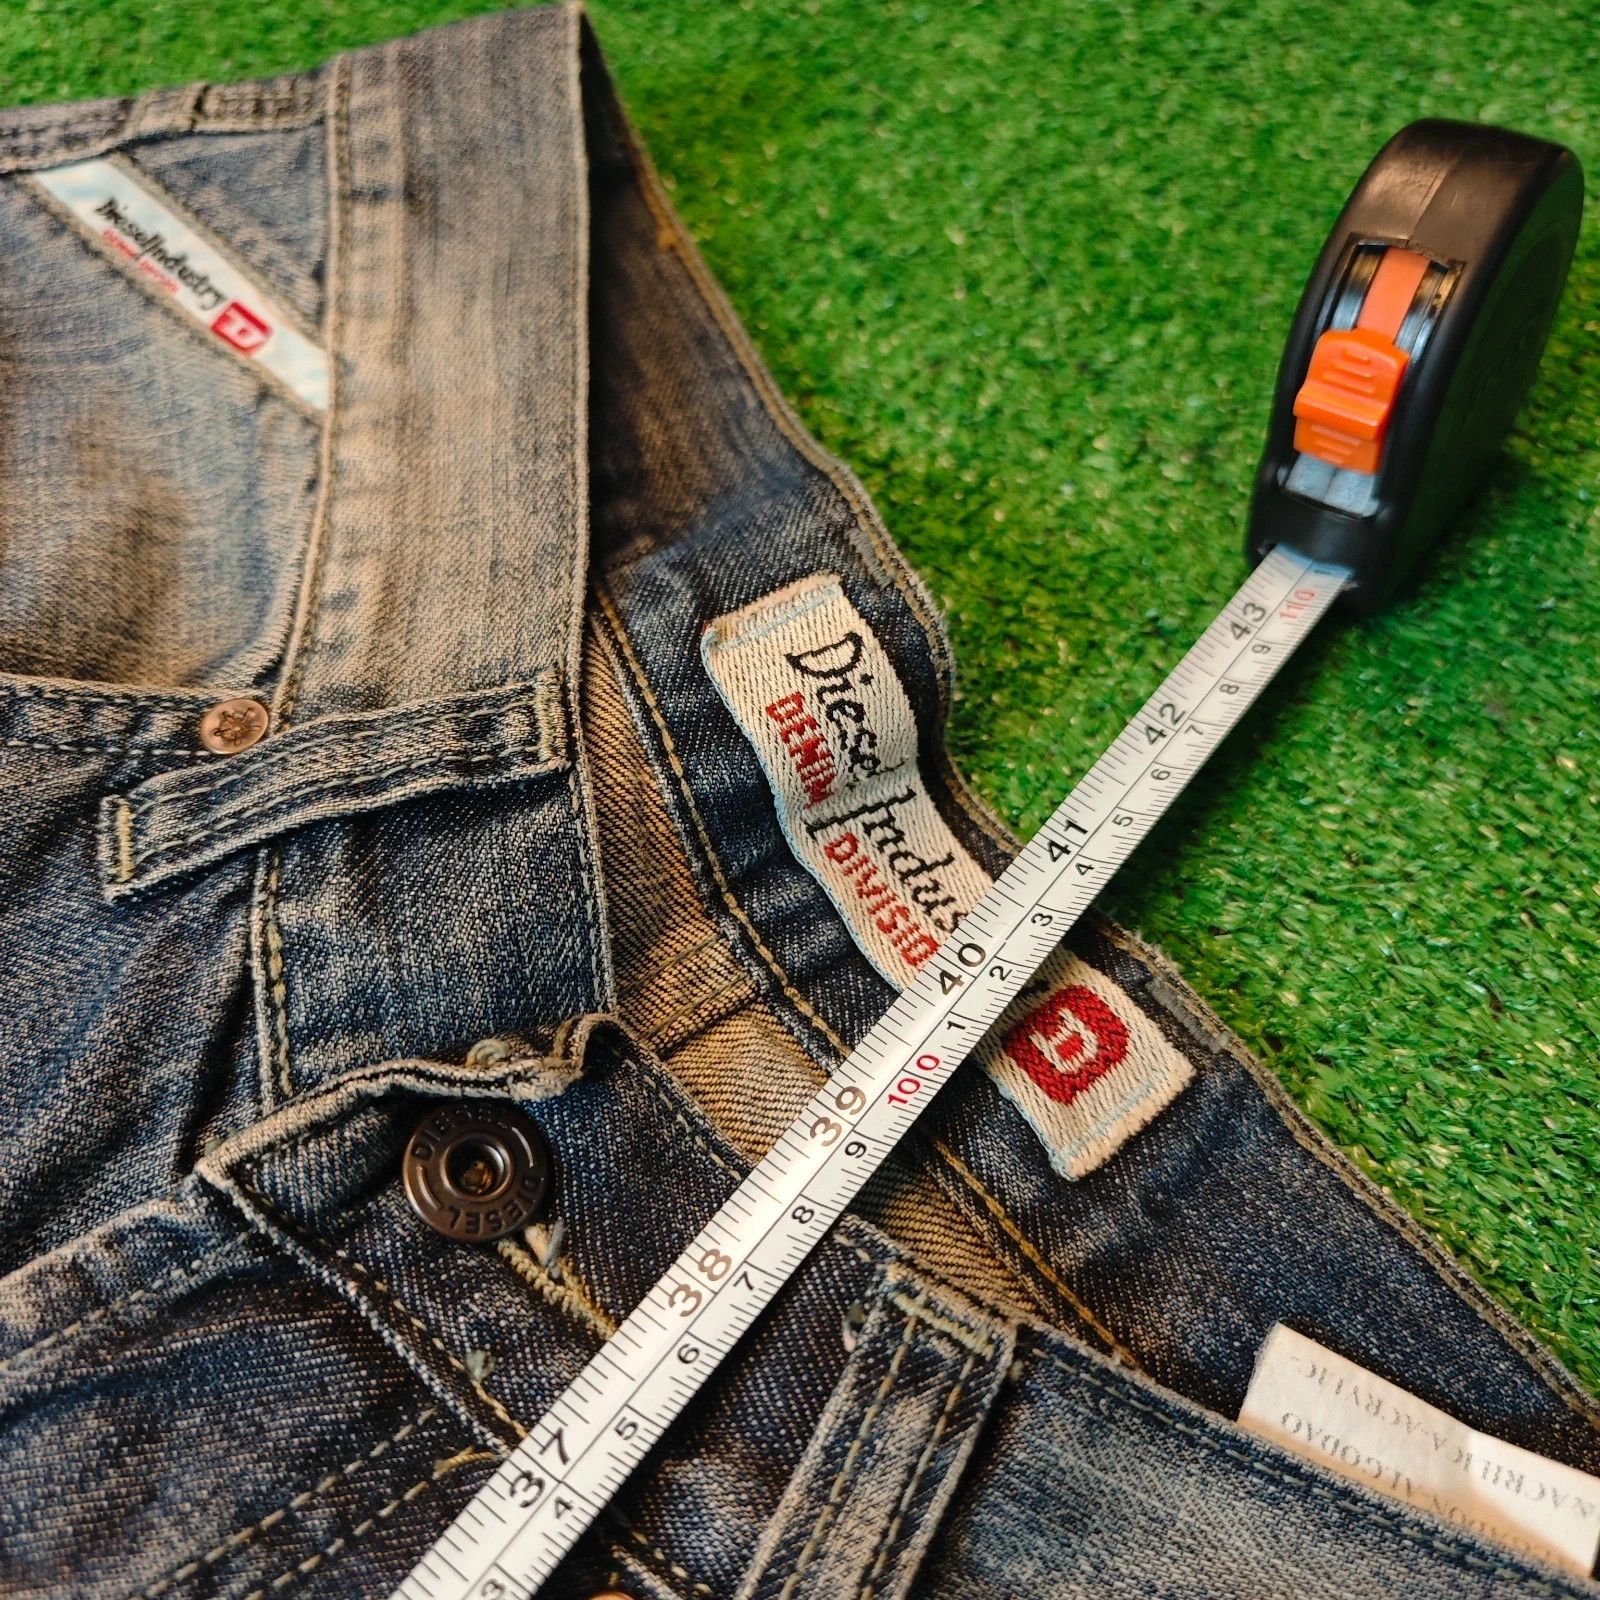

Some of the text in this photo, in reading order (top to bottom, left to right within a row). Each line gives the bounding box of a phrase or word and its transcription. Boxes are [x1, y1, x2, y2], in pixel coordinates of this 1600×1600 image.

[480, 1577, 507, 1599] 3
[551, 1498, 577, 1520] 4
[614, 1416, 640, 1441] 5
[678, 1343, 700, 1365] 6
[733, 1270, 760, 1293] 7
[791, 1205, 815, 1225] 8
[844, 1140, 868, 1159] 9
[887, 1054, 940, 1107] 100
[946, 1020, 967, 1033] 1
[989, 964, 1014, 982] 2
[1030, 911, 1054, 927] 3
[1074, 854, 1095, 877] 4
[1111, 810, 1134, 828] 5
[1150, 767, 1171, 782] 6
[1183, 723, 1205, 737] 7
[1219, 682, 1240, 695] 8
[1251, 642, 1272, 656] 9
[1279, 588, 1317, 622] 110
[508, 601, 1267, 1509] 37 38 39 40 41 42 43
[805, 785, 967, 934] Indus
[824, 831, 943, 971] DIVISIO
